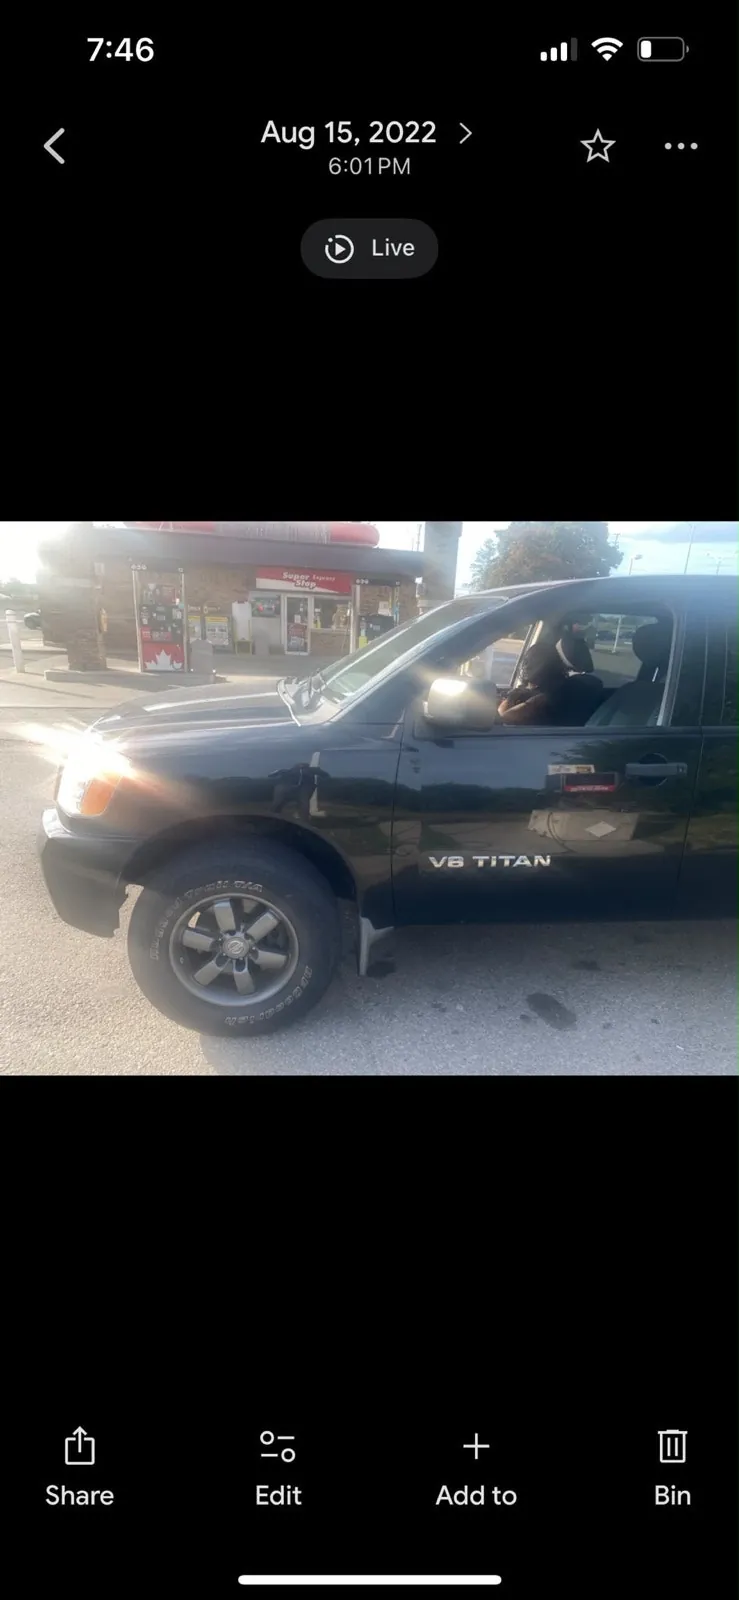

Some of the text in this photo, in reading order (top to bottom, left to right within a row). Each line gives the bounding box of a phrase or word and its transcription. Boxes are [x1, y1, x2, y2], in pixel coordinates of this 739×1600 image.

[282, 571, 310, 581] Super
[294, 580, 317, 589] Stop
[428, 855, 551, 868] V8 TITAN
